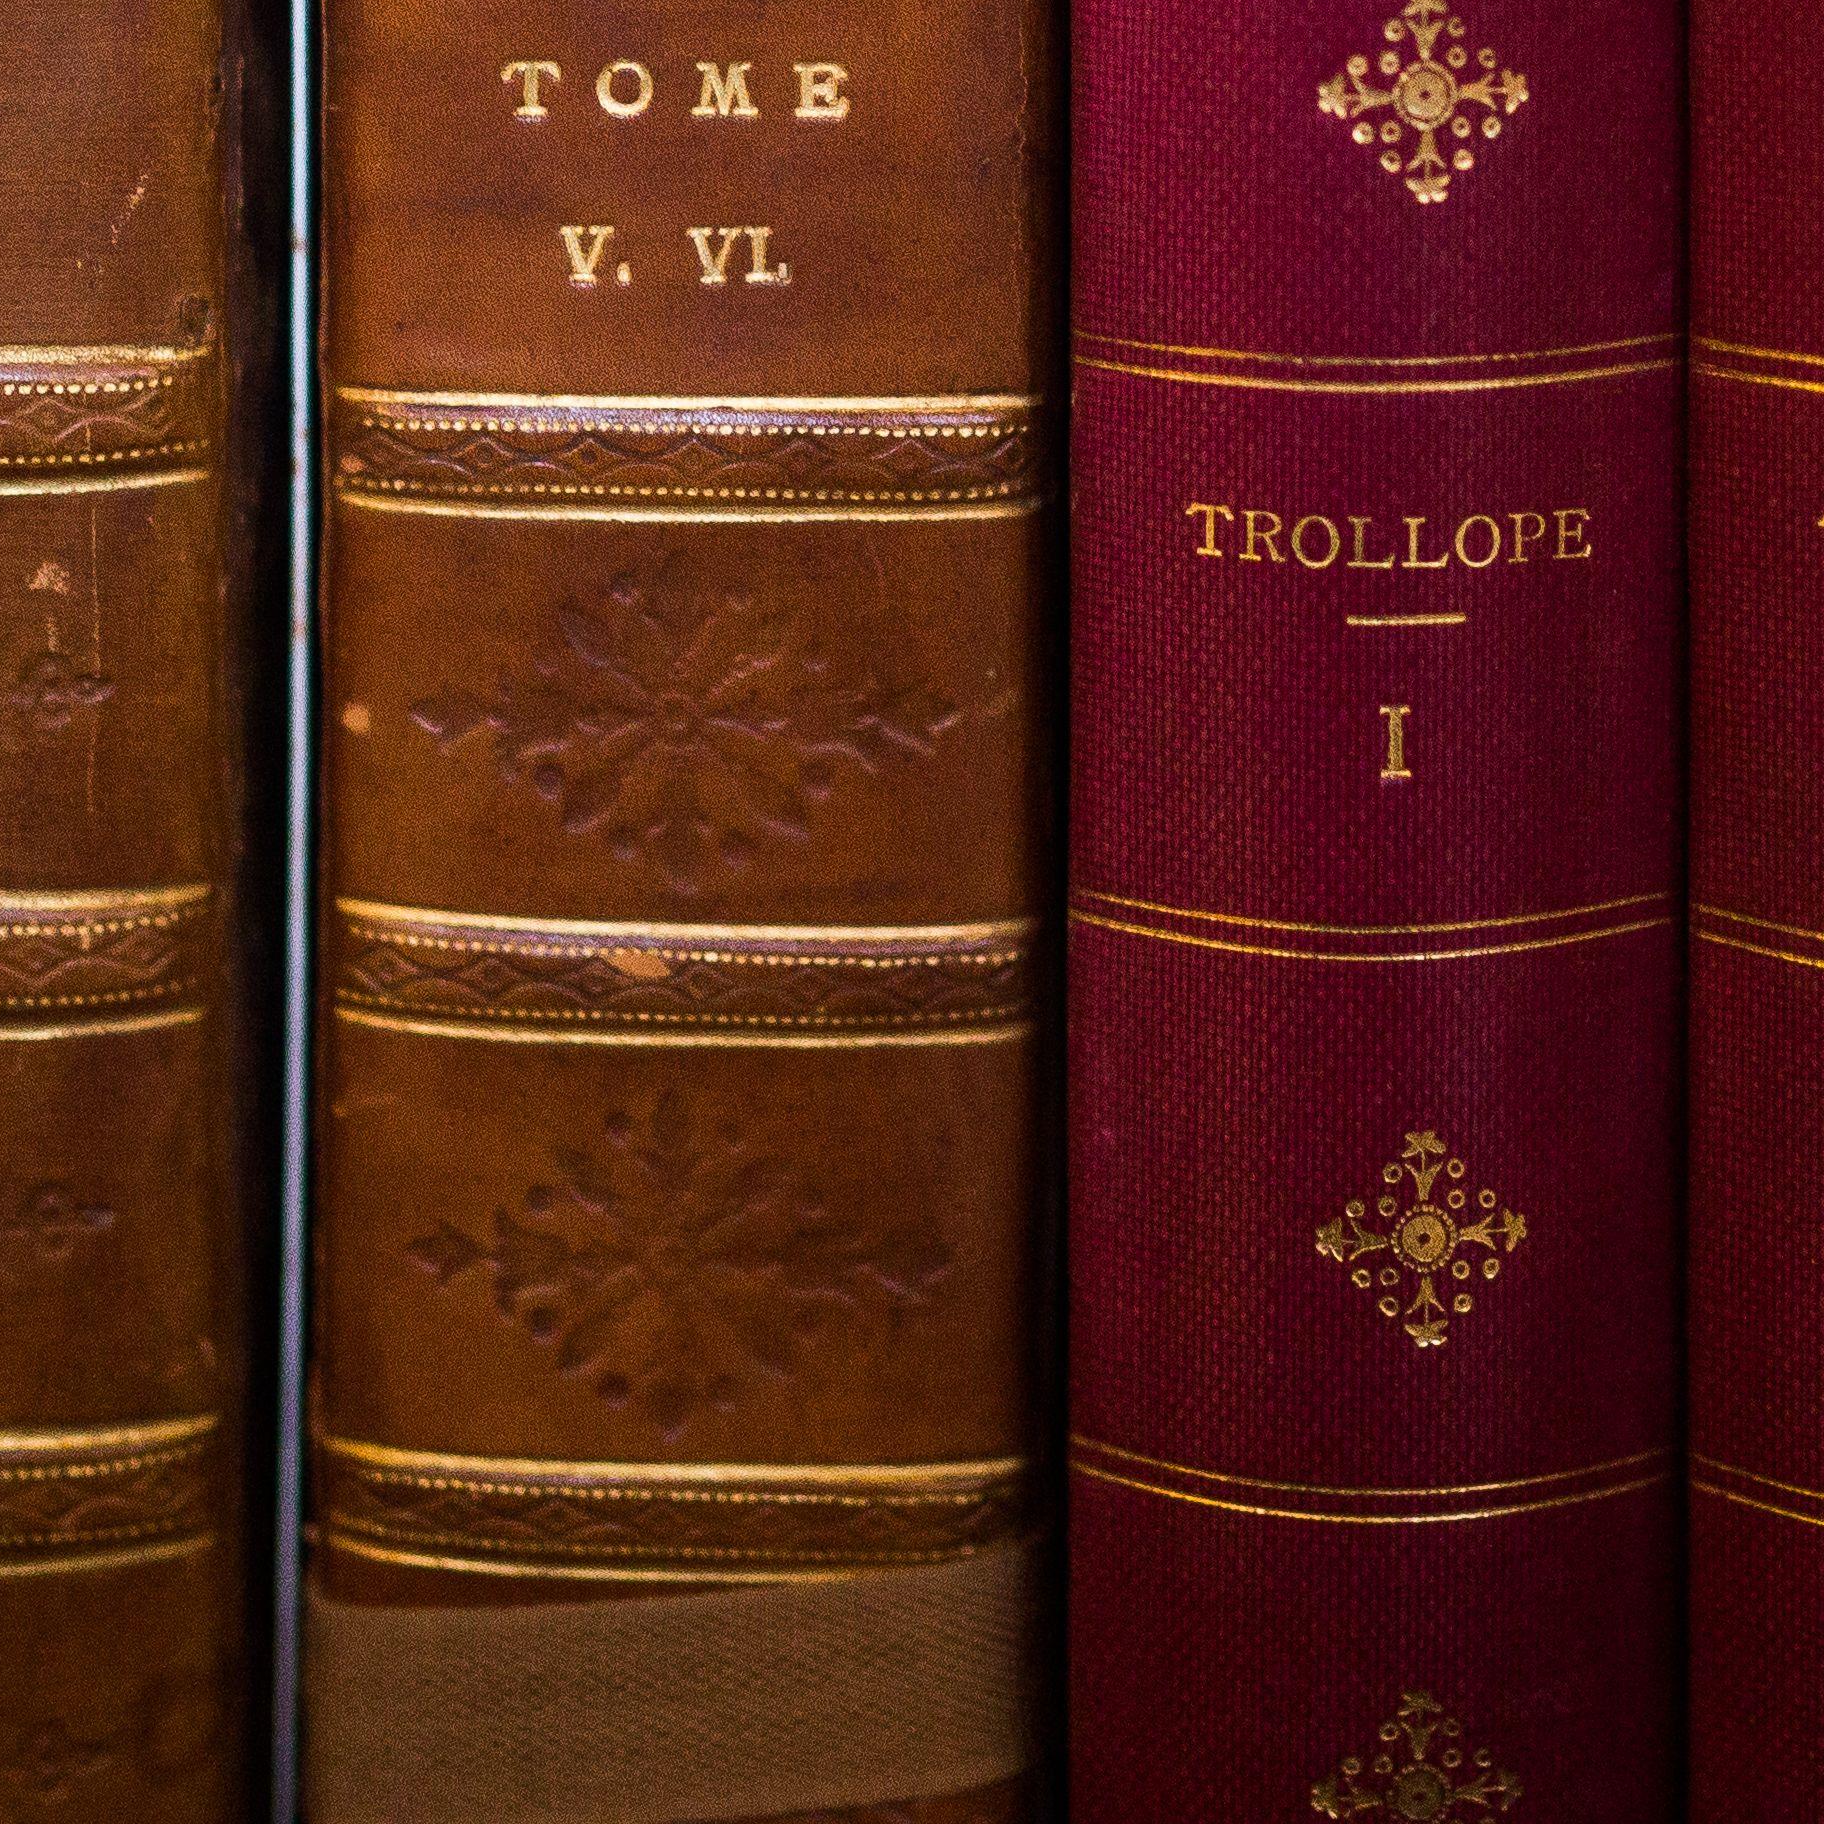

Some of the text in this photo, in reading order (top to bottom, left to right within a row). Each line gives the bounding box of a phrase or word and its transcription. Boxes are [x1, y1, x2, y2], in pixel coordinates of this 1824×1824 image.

[500, 60, 851, 122] TOME
[560, 224, 793, 287] V. VI.
[1185, 501, 1593, 570] TROLLOPE
[1379, 703, 1412, 778] I
